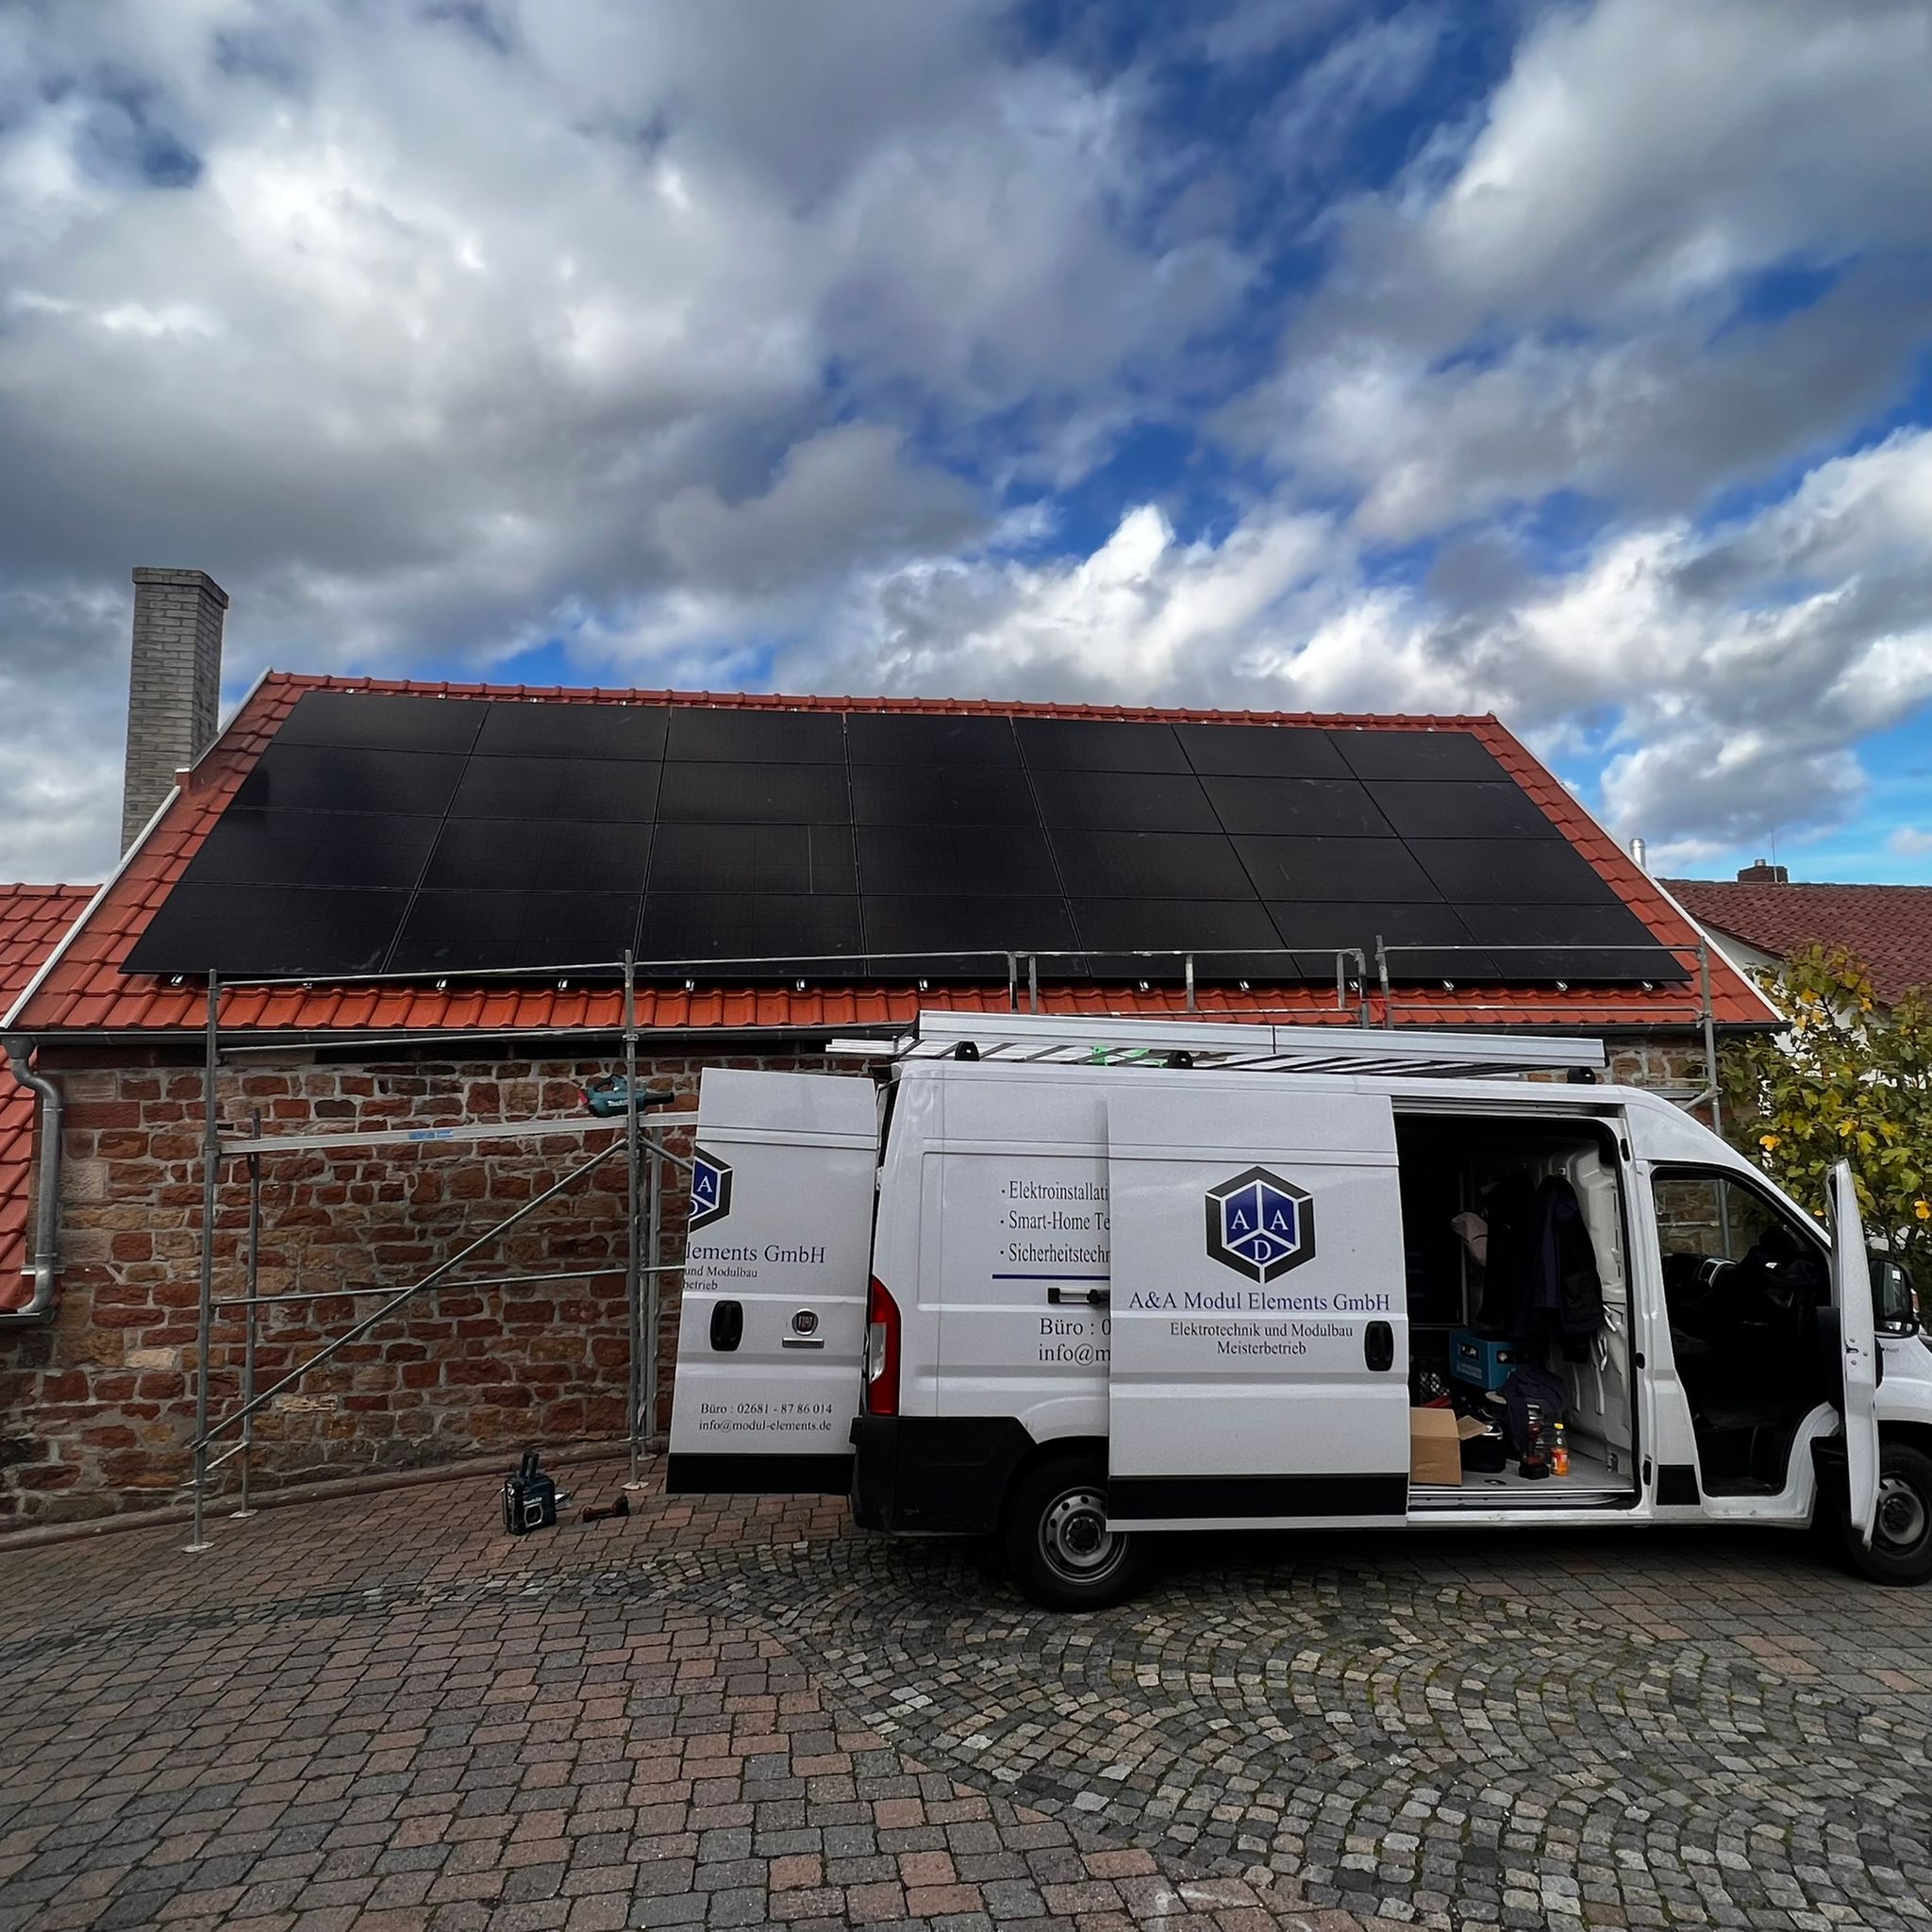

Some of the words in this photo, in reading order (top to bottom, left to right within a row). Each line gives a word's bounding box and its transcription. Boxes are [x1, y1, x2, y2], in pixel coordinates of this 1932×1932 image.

[696, 1175, 713, 1193] A
[1008, 1209, 1091, 1230] Smart-Home
[1094, 1212, 1110, 1231] Te
[764, 1243, 826, 1263] GmbH
[707, 1266, 758, 1278] Modulbau
[1128, 1291, 1177, 1309] A&A
[1183, 1291, 1242, 1309] Modul
[1247, 1291, 1328, 1310] Elements
[1333, 1292, 1391, 1311] GmbH
[1040, 1316, 1084, 1336] Büro
[1170, 1321, 1261, 1337] Elektrotechnik
[1264, 1323, 1288, 1337] und
[1291, 1323, 1354, 1338] Modulbau
[1217, 1340, 1307, 1356] Meisterbetrieb
[701, 1403, 727, 1415] Büro
[737, 1403, 769, 1414] 02681
[780, 1404, 794, 1414] 87
[797, 1404, 810, 1414] 86
[812, 1404, 833, 1414] 014
[699, 1419, 832, 1433] info@modul-elements.de
